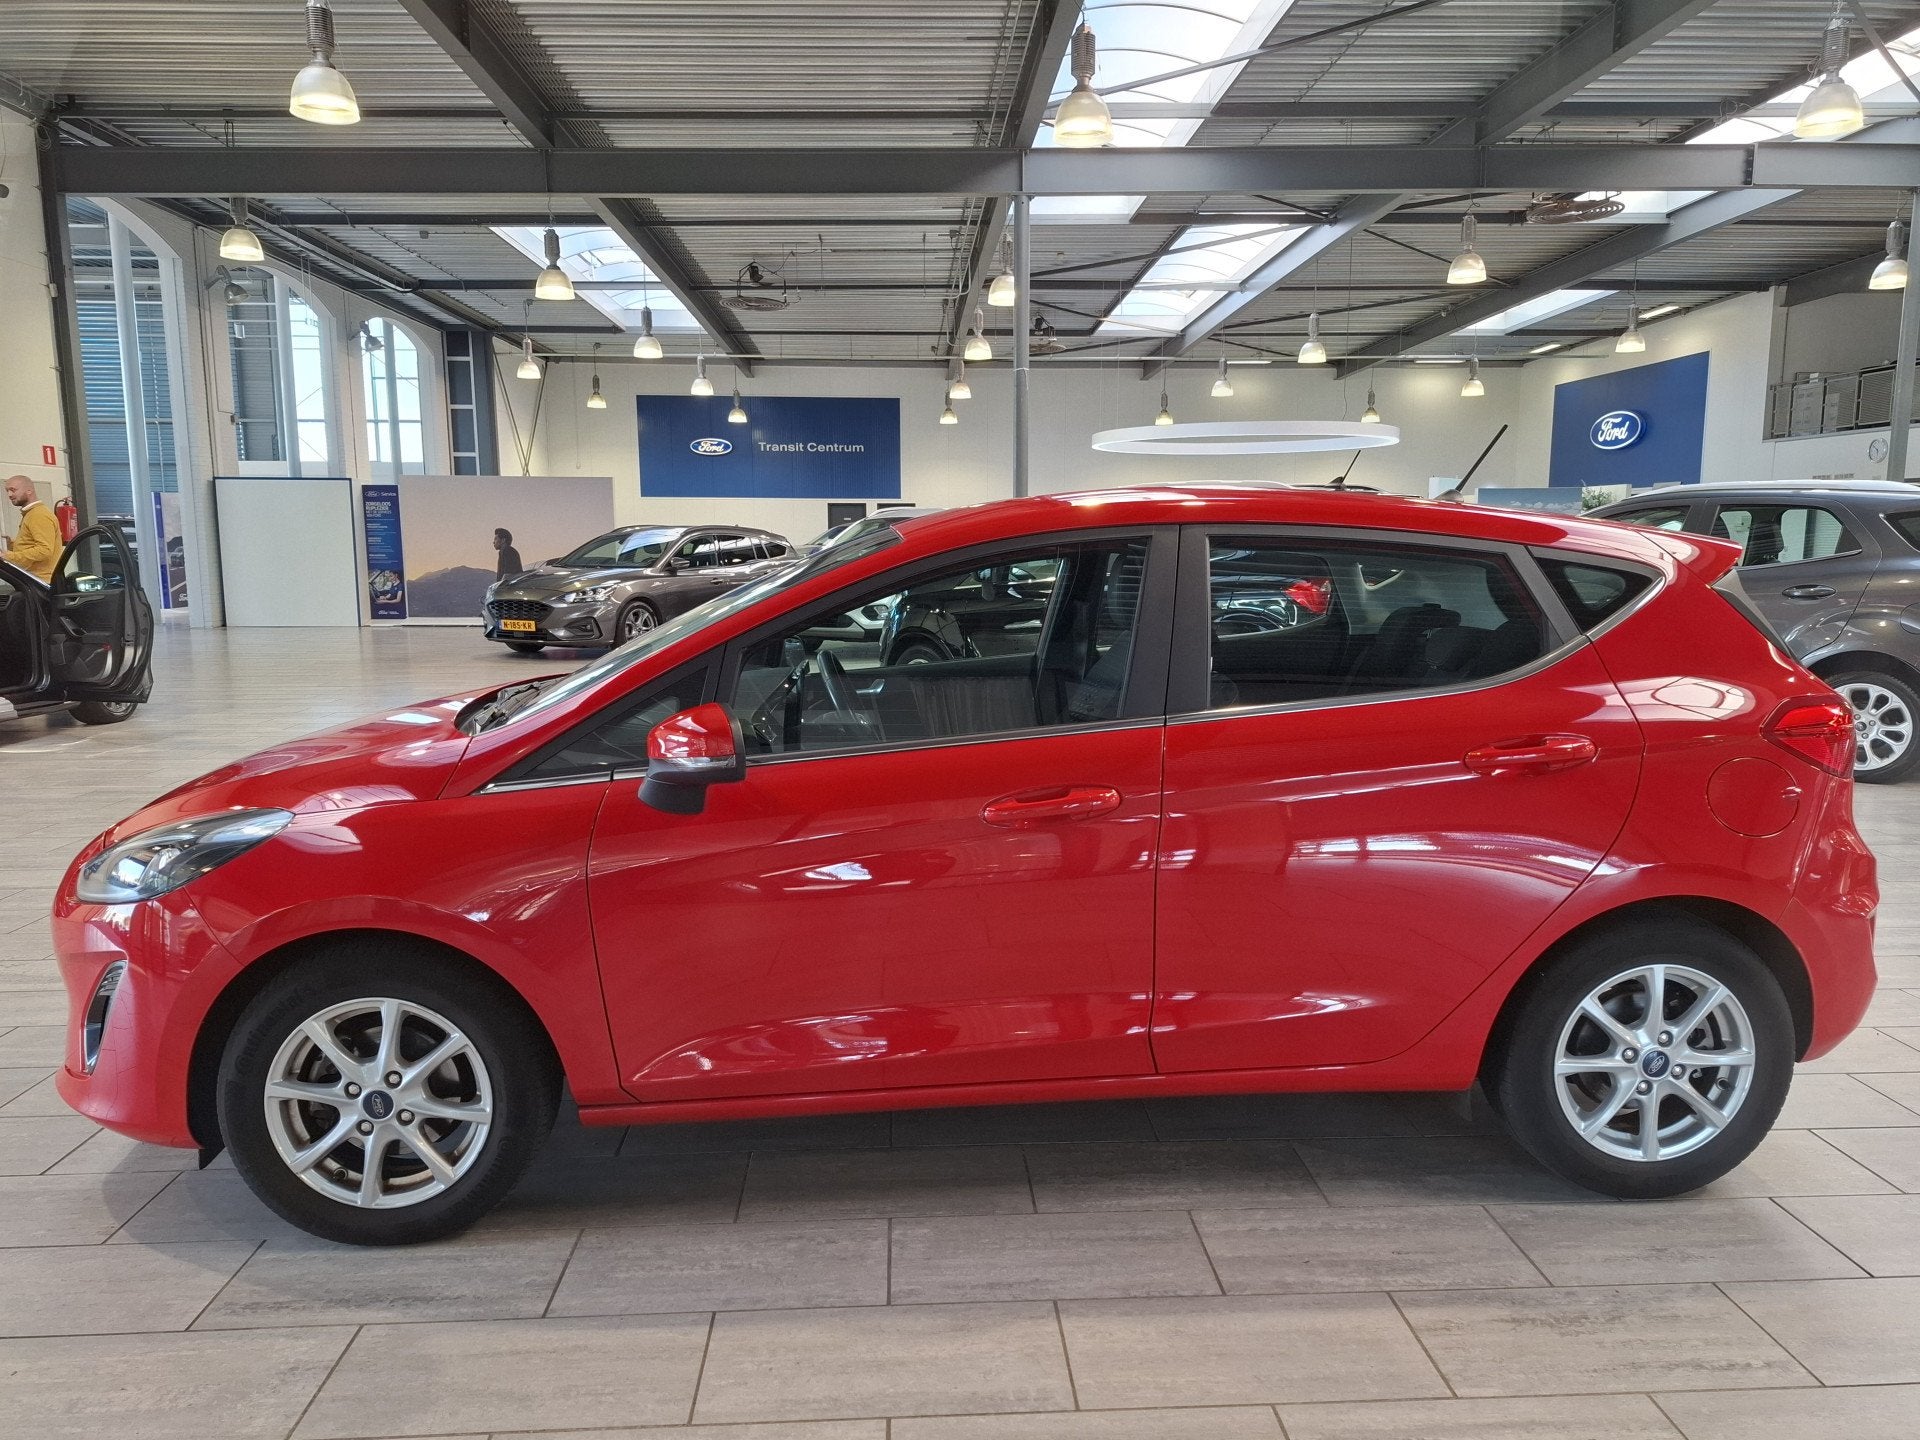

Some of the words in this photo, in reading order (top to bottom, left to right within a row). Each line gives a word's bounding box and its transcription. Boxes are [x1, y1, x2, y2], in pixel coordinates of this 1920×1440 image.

[1597, 417, 1630, 442] Ford
[758, 442, 804, 452] Transit
[807, 442, 865, 453] Centrum
